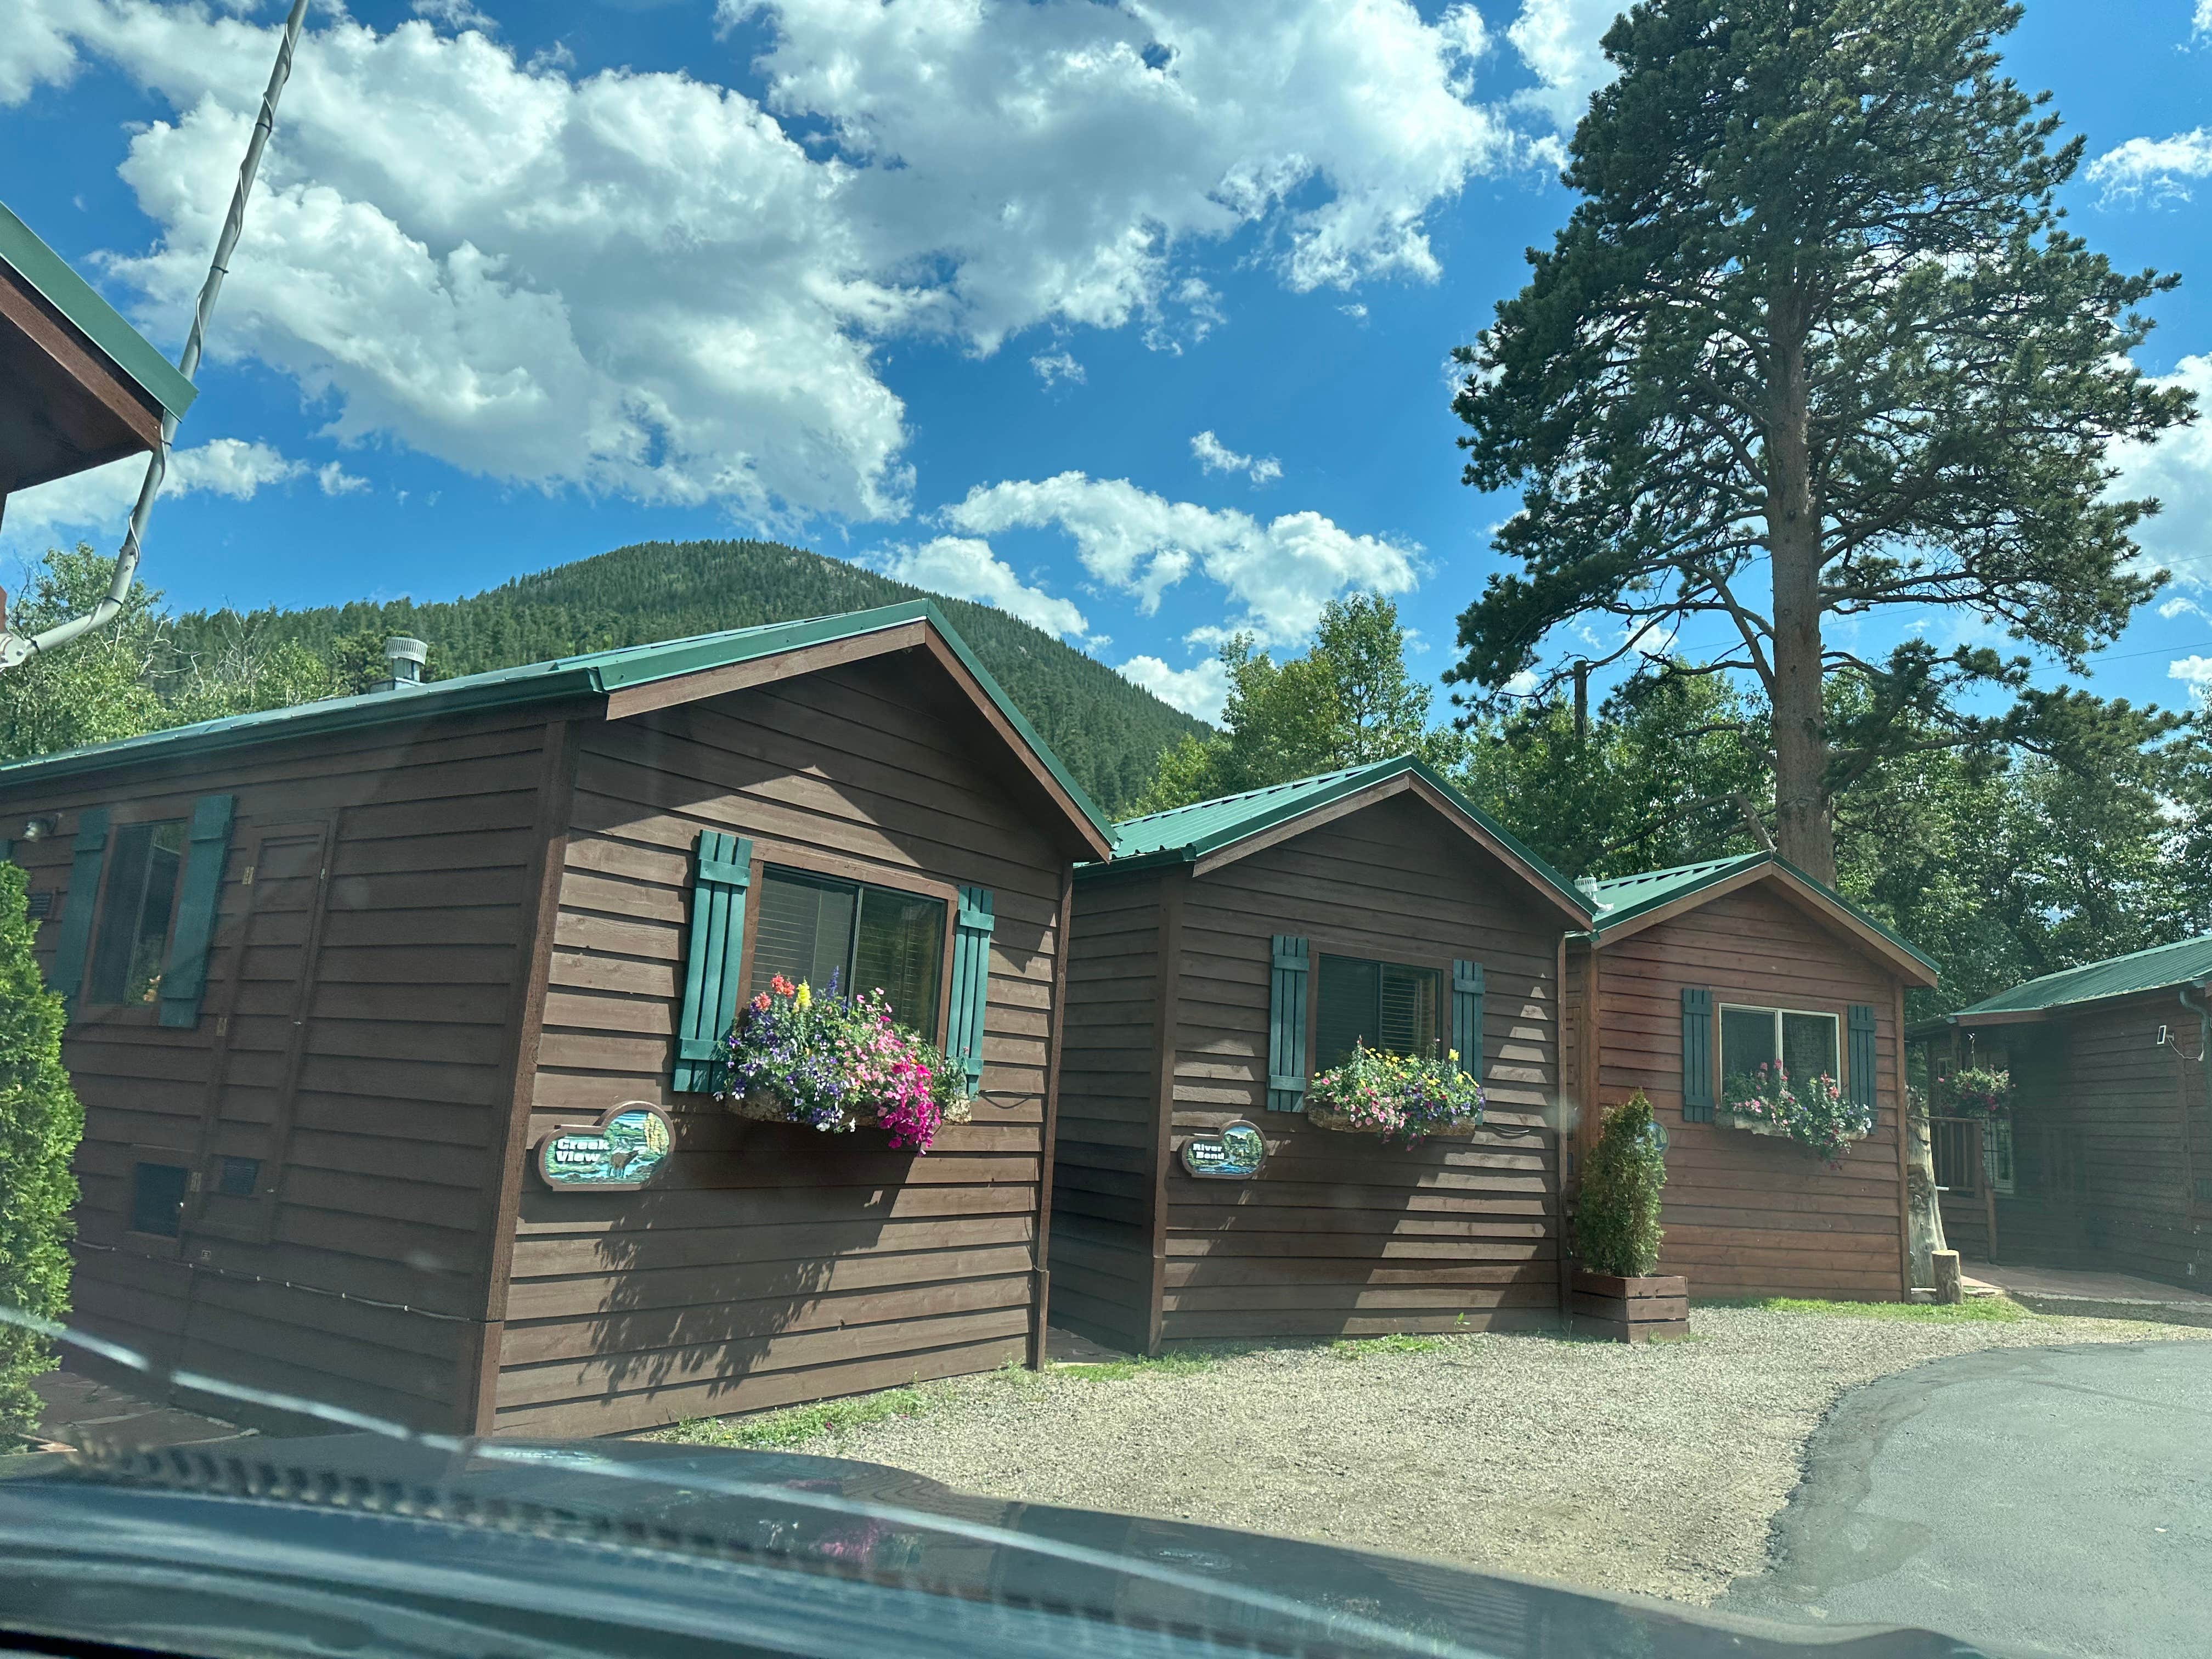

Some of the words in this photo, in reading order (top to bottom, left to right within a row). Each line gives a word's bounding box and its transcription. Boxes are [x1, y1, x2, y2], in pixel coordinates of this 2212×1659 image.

[557, 1138, 610, 1150] Creek
[1193, 1143, 1222, 1152] River
[556, 1151, 600, 1162] View
[1196, 1151, 1224, 1160] Bend
